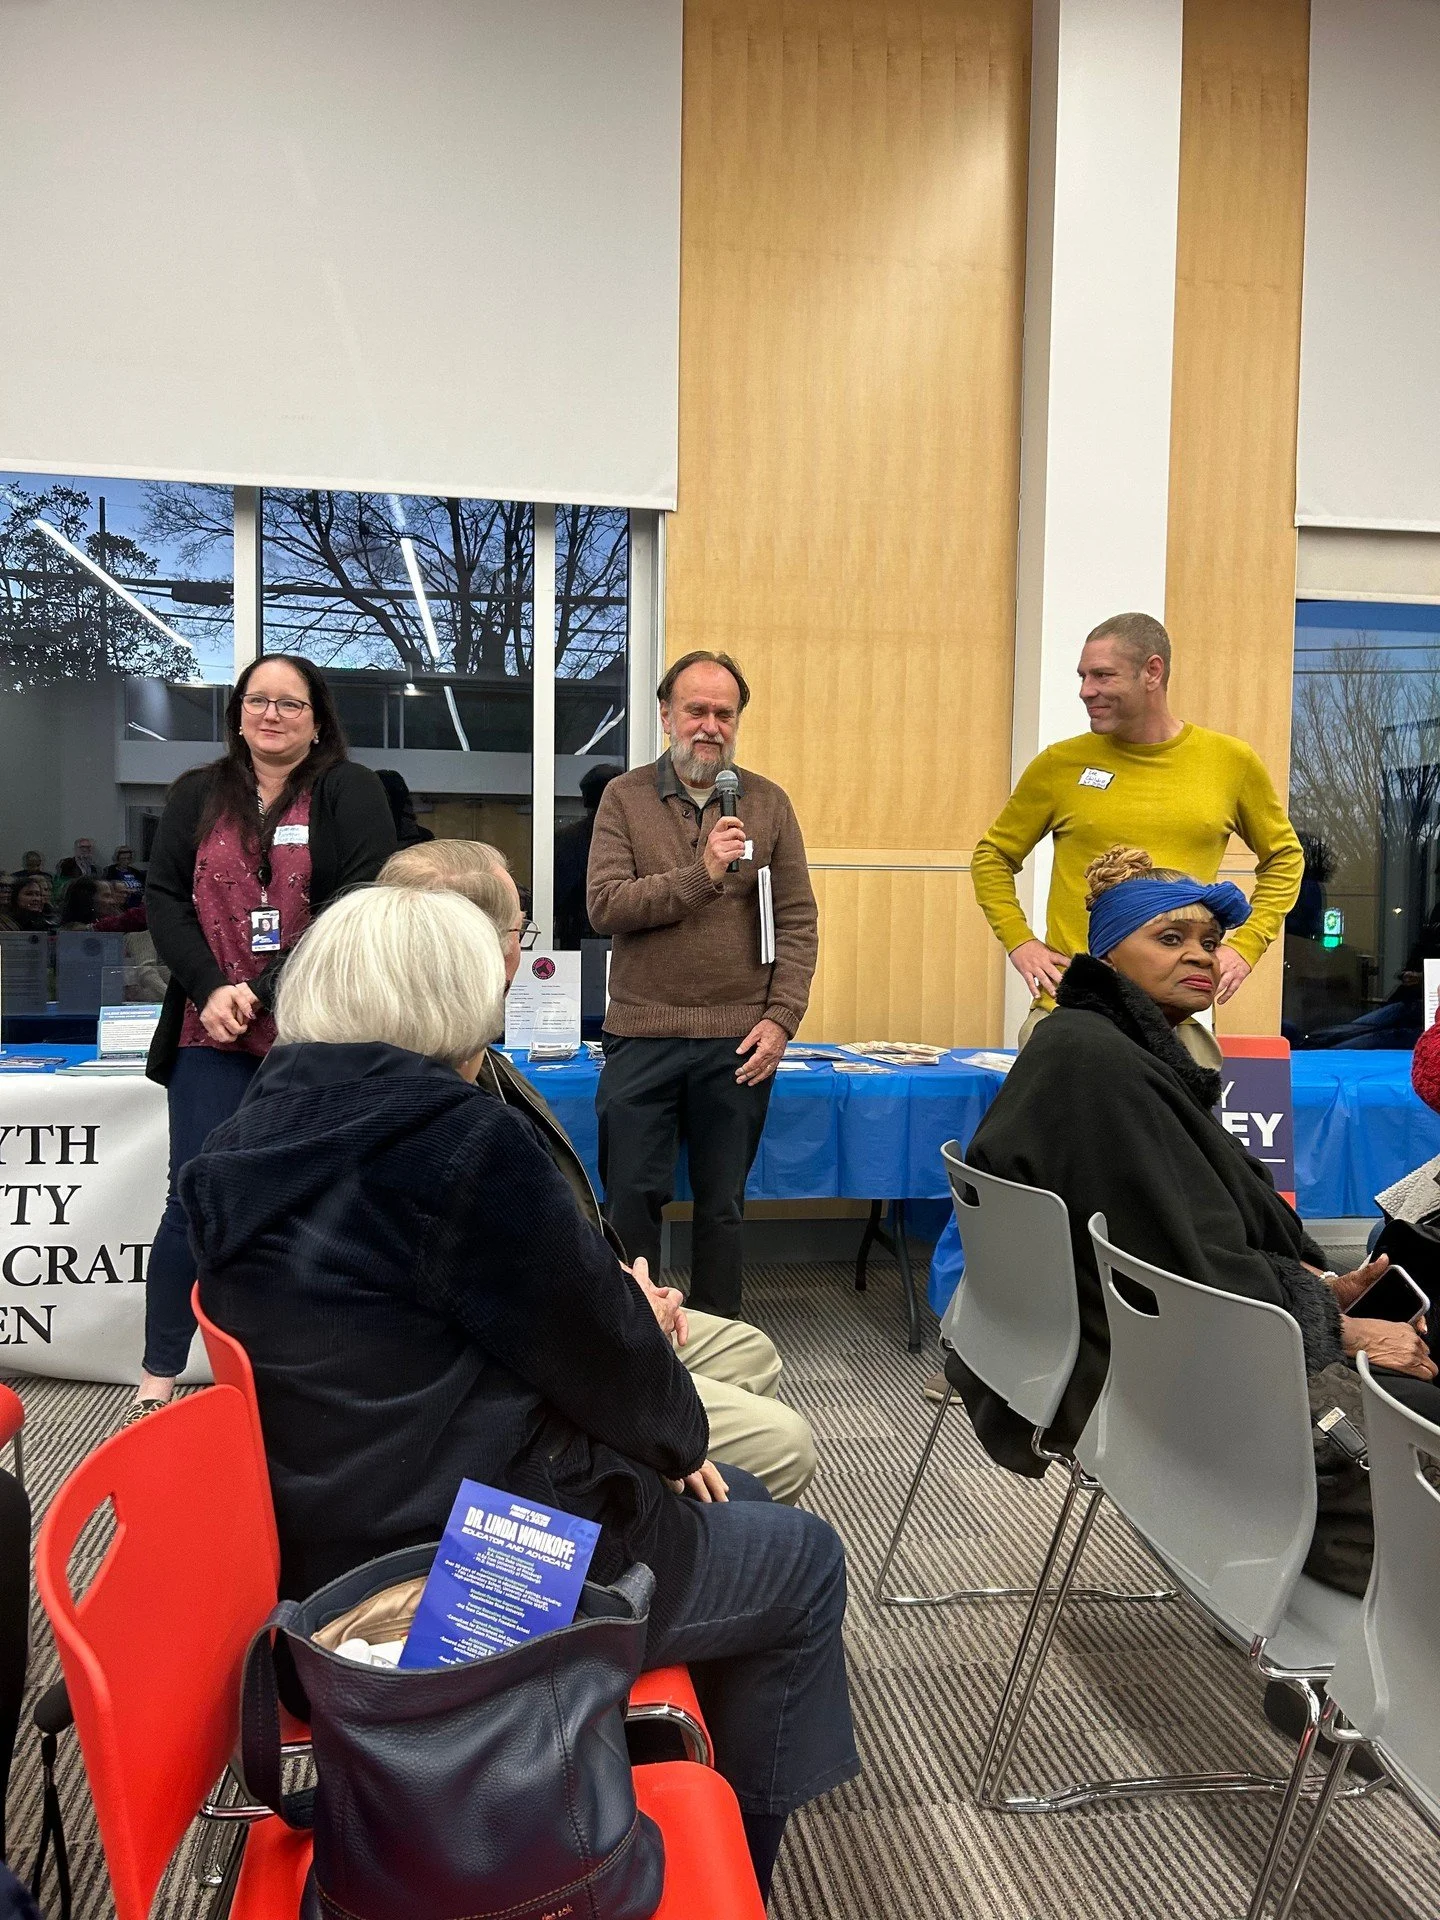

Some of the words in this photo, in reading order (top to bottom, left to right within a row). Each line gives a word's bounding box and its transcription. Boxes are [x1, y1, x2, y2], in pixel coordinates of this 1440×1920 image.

[1221, 1081, 1236, 1109] Y
[1221, 1112, 1284, 1147] EY
[0, 1184, 82, 1225] TY
[461, 1526, 505, 1546] EDUCATOR
[505, 1543, 524, 1553] AND
[525, 1550, 572, 1570] ADVOCATE
[464, 1506, 484, 1530] DR.
[483, 1513, 519, 1542] LINDA
[517, 1524, 576, 1562] WINIKOFF:
